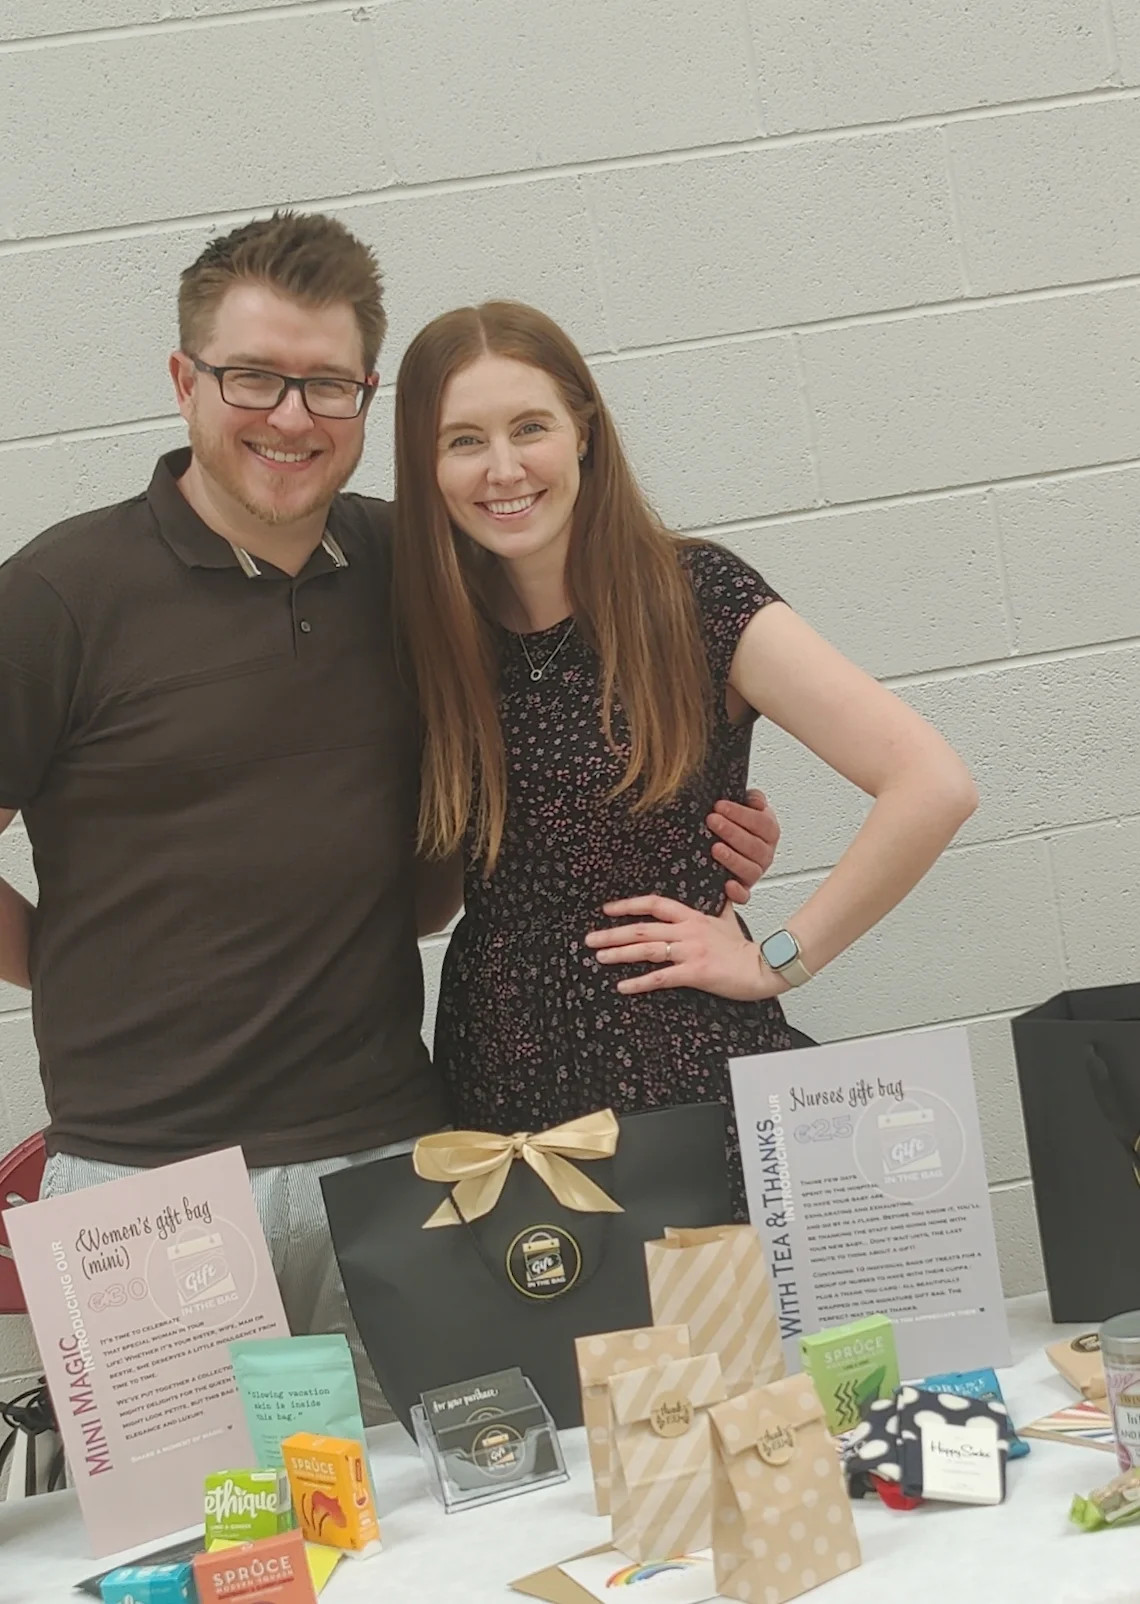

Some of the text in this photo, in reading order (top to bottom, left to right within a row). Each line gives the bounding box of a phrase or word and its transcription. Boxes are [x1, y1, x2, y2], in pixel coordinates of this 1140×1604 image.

[848, 1079, 874, 1108] gift
[878, 1078, 904, 1102] bag
[768, 1094, 796, 1223] INTRODUCING OUR
[892, 1138, 925, 1162] Gift
[884, 1170, 944, 1184] IN THE BAG
[76, 1196, 212, 1252] Women's gift bag
[756, 1118, 803, 1340] WITH TEA & THANKS
[82, 1246, 130, 1280] (mini)
[532, 1257, 554, 1274] Gift
[185, 1264, 216, 1292] Gift
[551, 1276, 566, 1284] BAG
[52, 1240, 96, 1373] INTRODUCING OUR
[182, 1292, 239, 1316] IN THE BAG
[99, 1336, 113, 1345] IT'S
[114, 1331, 129, 1340] TIME
[142, 1316, 180, 1332] CELEBRATE
[103, 1346, 120, 1356] THAT
[121, 1337, 150, 1350] SPECIAL
[124, 1346, 158, 1361] WHETHER
[173, 1336, 191, 1346] YOUR
[136, 1362, 149, 1370] SHE
[151, 1350, 185, 1365] DESERVES
[193, 1341, 214, 1352] LITTLE
[258, 1321, 276, 1332] FROM
[112, 1381, 127, 1390] TIME
[115, 1394, 139, 1406] WE'VE
[140, 1389, 153, 1398] PUT
[155, 1378, 189, 1393] TOGETHER
[196, 1364, 233, 1380] COLLECTIO
[288, 1388, 330, 1398] vacation
[58, 1334, 114, 1476] MINI MAGIC
[119, 1404, 144, 1417] MIGHTY
[145, 1394, 178, 1409] DELIGHTS
[179, 1389, 193, 1398] FOR
[194, 1384, 207, 1393] THE
[122, 1417, 143, 1429] MIGHT
[144, 1411, 162, 1421] LOOK
[190, 1398, 203, 1407] BUT
[204, 1393, 219, 1402] THIS
[220, 1388, 234, 1397] BAG
[291, 1400, 321, 1408] inside
[433, 1400, 446, 1414] for
[125, 1410, 204, 1440] ELEGANCE AND LUXURY
[930, 1440, 990, 1458] Happy Socks
